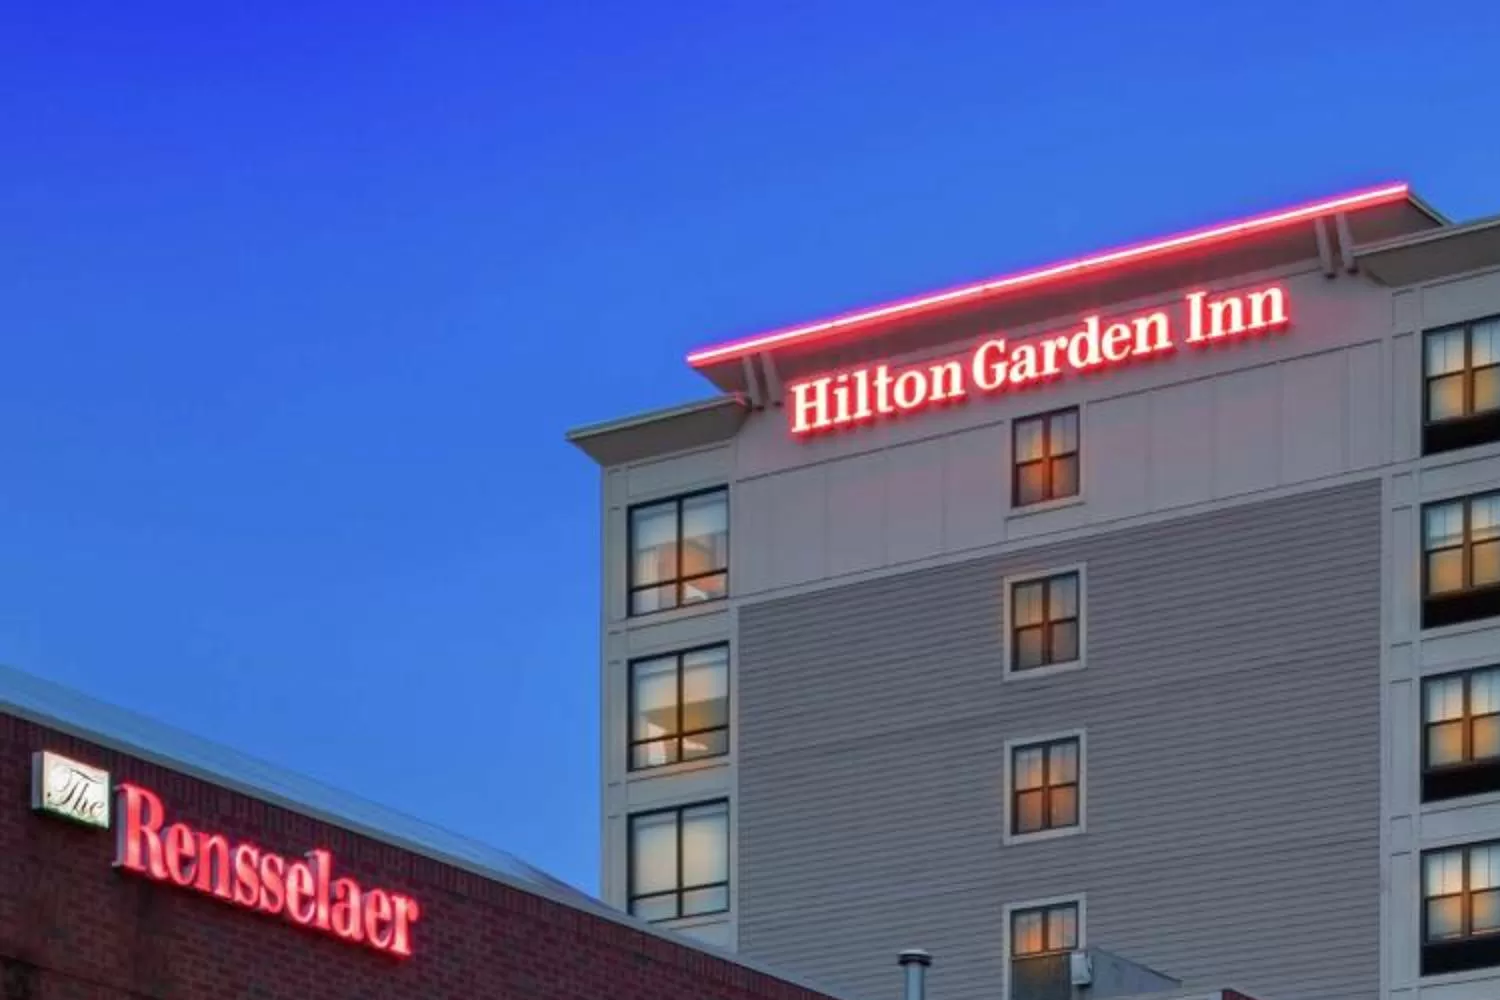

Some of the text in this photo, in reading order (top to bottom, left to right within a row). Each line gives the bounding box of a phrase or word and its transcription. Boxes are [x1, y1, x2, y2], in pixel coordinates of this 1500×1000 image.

[790, 286, 1289, 433] Hilton Garden Inn
[47, 765, 420, 957] The Rensselaer
